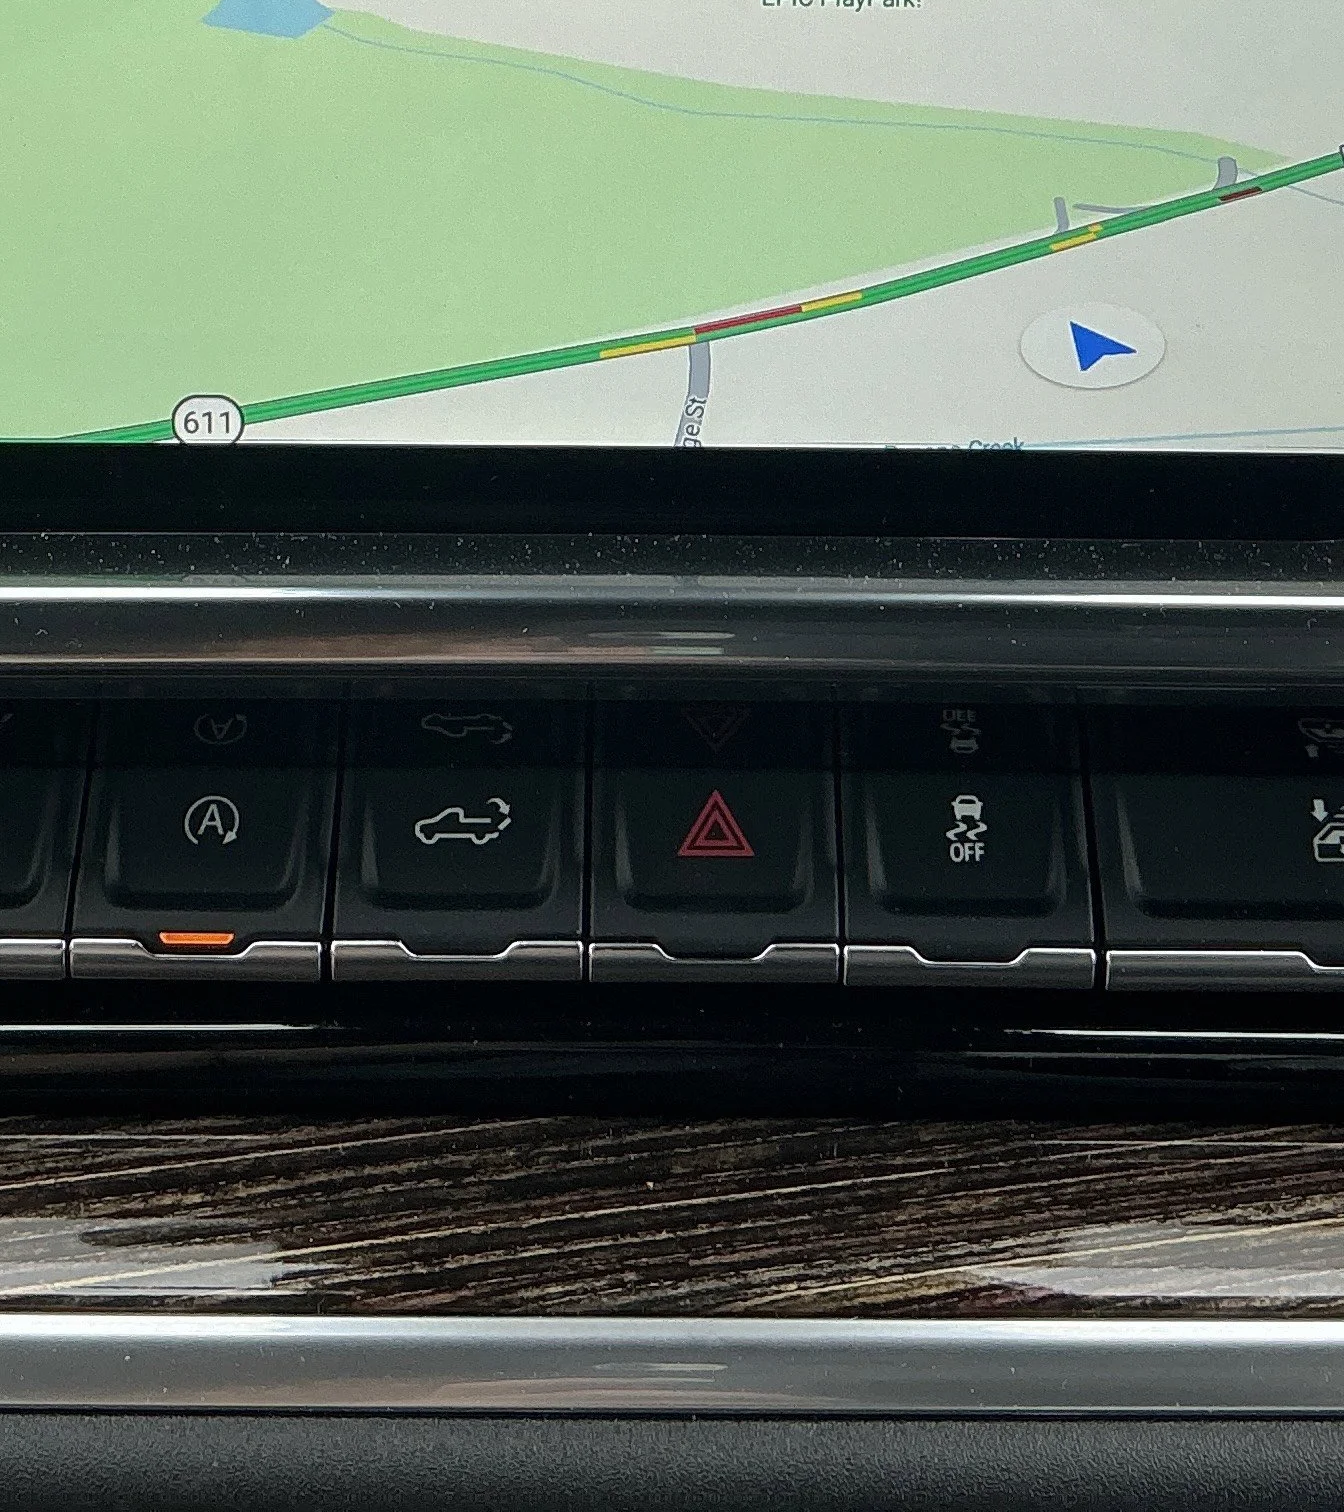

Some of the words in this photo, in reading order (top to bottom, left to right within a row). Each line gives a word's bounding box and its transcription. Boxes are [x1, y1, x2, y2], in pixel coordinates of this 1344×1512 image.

[685, 397, 708, 418] St
[184, 410, 231, 434] 611
[950, 843, 985, 862] OFF
